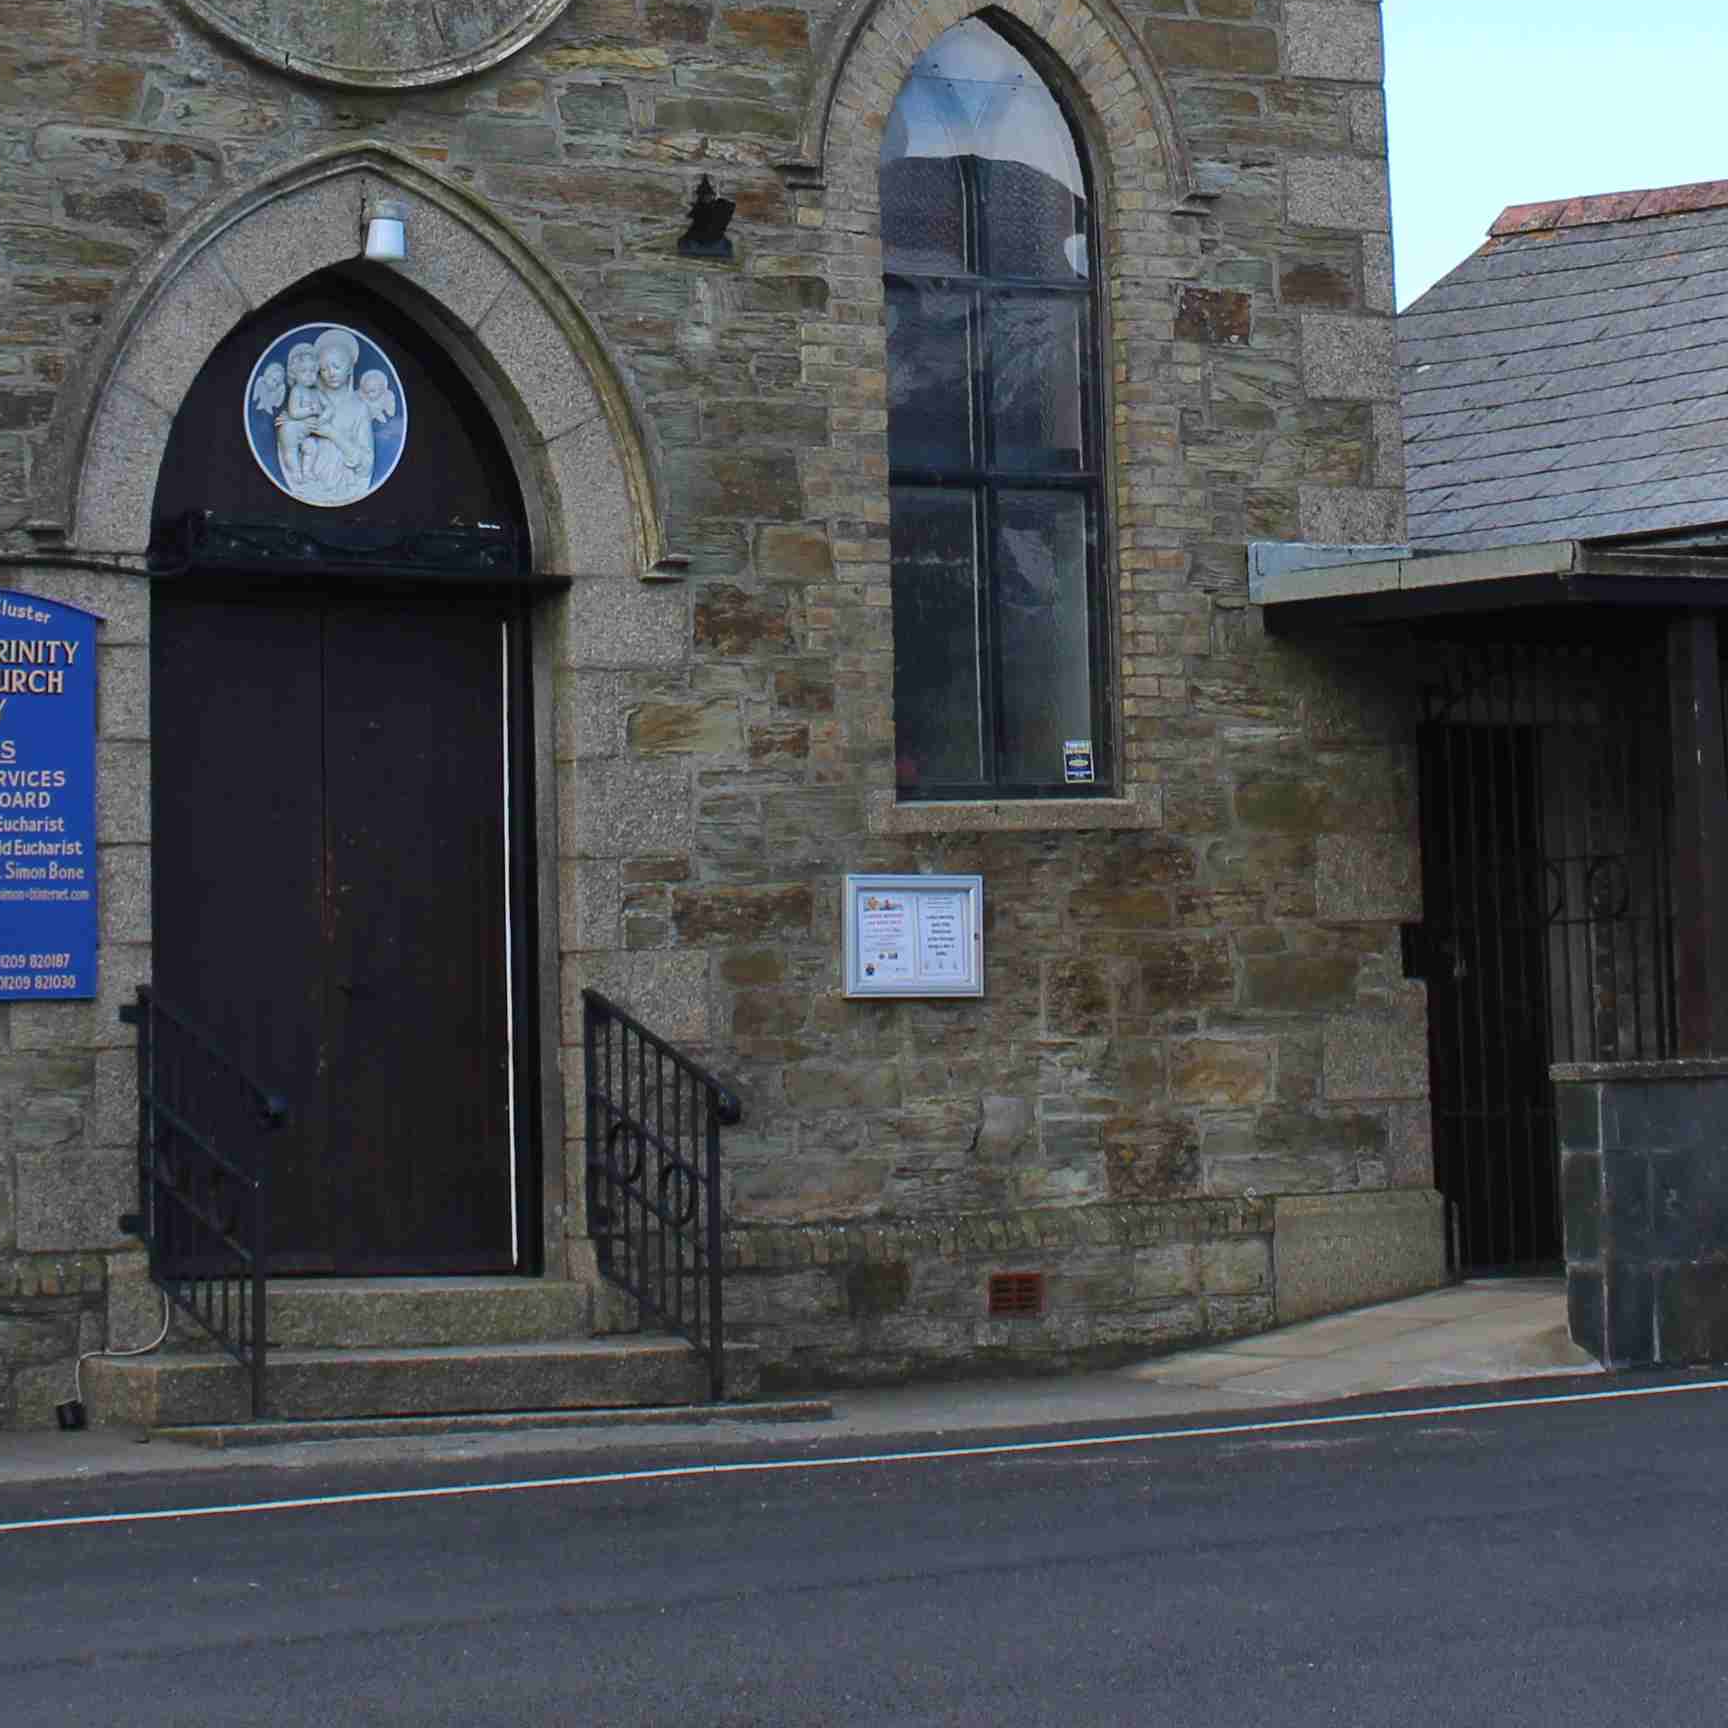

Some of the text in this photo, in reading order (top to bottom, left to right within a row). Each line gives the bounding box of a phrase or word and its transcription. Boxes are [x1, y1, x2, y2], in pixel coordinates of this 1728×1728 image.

[14, 839, 83, 856] Eucharist
[5, 860, 46, 880] Simon
[48, 860, 86, 880] Bone
